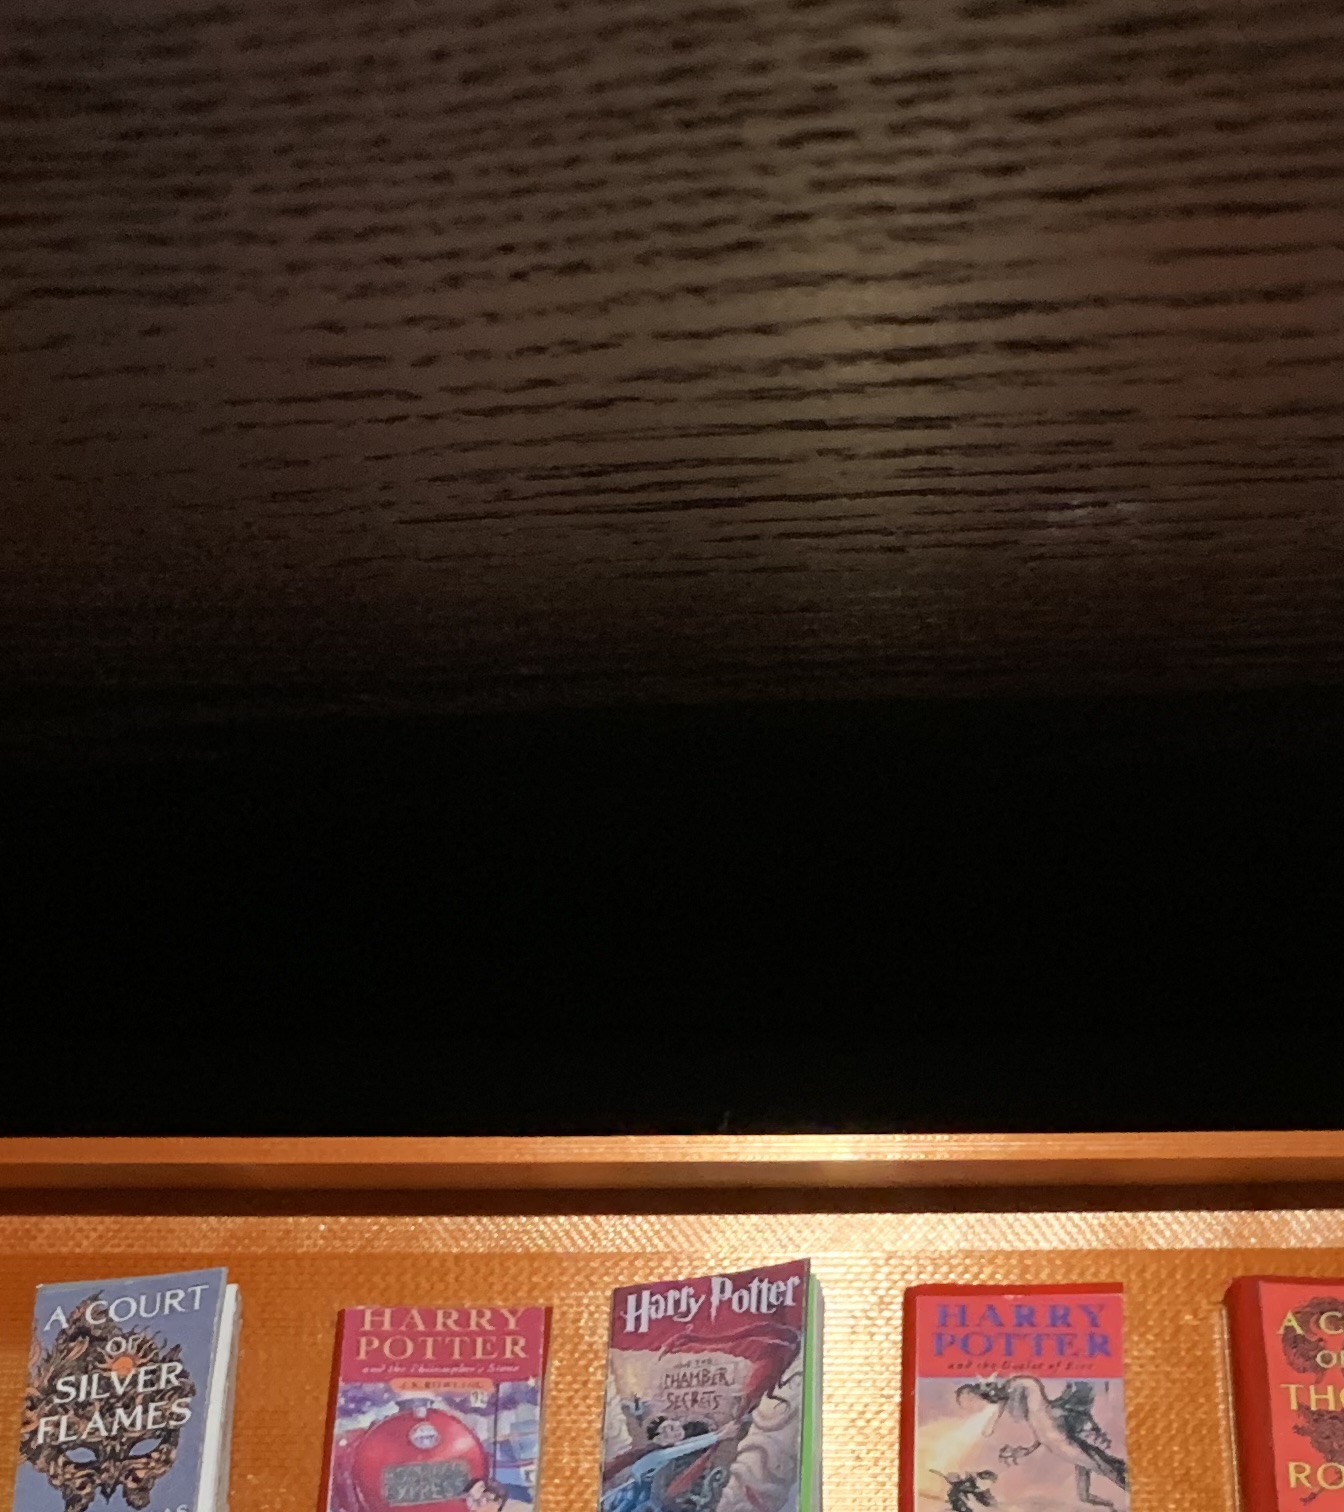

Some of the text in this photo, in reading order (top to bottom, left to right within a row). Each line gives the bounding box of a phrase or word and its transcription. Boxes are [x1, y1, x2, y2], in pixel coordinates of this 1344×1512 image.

[43, 1285, 209, 1332] A COURT
[620, 1275, 800, 1333] Harry Potter
[936, 1303, 1104, 1329] HARRY
[359, 1308, 526, 1331] HARRY
[1277, 1312, 1303, 1335] A
[356, 1334, 528, 1360] POTTER
[932, 1332, 1112, 1358] POTTER
[53, 1361, 183, 1404] SILVER
[36, 1398, 193, 1445] FLAMES
